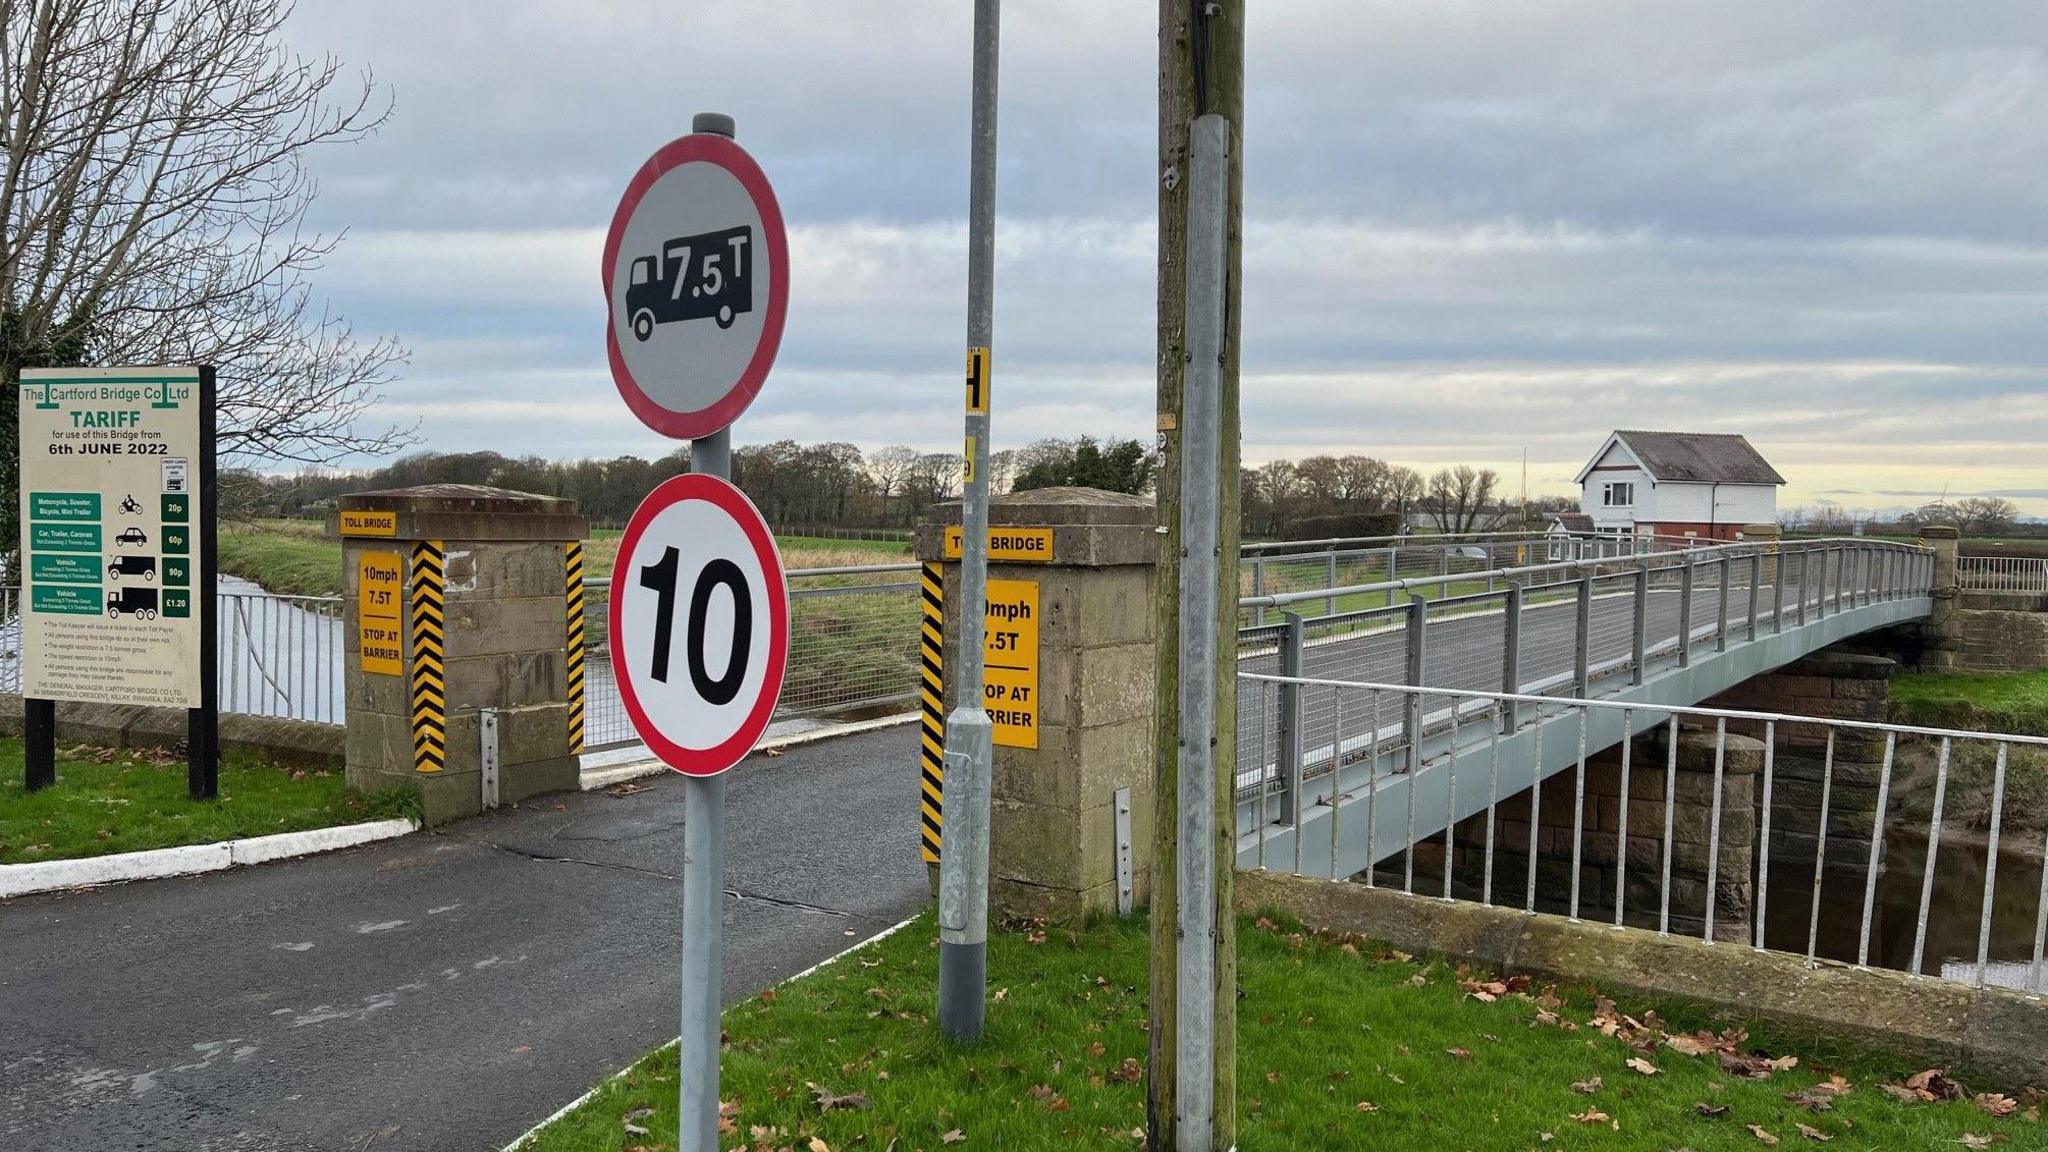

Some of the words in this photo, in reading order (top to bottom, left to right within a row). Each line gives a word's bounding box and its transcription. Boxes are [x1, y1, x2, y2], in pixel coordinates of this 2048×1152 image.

[24, 388, 43, 400] The
[50, 388, 97, 400] Cartford
[101, 387, 140, 403] Bridge
[144, 386, 161, 399] Co
[169, 386, 189, 399] Ltd
[70, 410, 140, 428] TARIFF
[52, 430, 63, 439] for
[82, 430, 91, 439] of
[92, 430, 108, 439] this
[111, 430, 138, 441] Bridge
[140, 430, 161, 439] from
[49, 443, 73, 455] 6th
[78, 443, 122, 455] JUNE
[127, 443, 168, 455] 2022
[168, 503, 182, 514] 20p
[344, 517, 362, 528] TOLL
[364, 518, 392, 529] BRIDGE
[168, 535, 182, 546] 60p
[991, 537, 1045, 551] BRIDGE
[168, 567, 183, 578] 90p
[364, 566, 397, 584] 10mph
[166, 598, 186, 608] £1.20
[369, 590, 392, 605] 7.5T
[640, 546, 752, 705] 10
[364, 629, 385, 641] STOP
[387, 631, 398, 642] AT
[364, 646, 400, 660] BARRIER
[983, 684, 1006, 699] OP
[1010, 687, 1031, 701] AT
